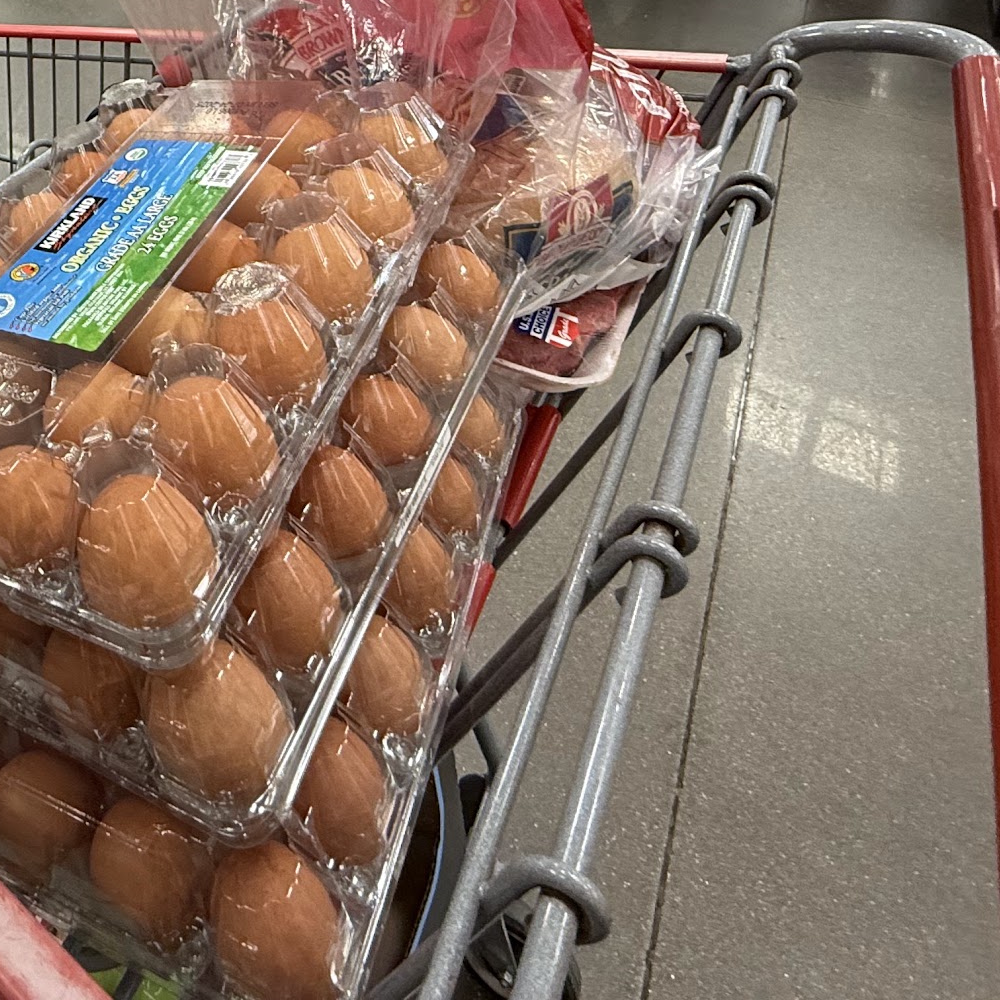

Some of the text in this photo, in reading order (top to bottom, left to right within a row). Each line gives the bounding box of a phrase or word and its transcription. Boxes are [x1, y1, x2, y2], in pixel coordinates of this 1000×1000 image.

[38, 197, 97, 249] KIRKLAND
[60, 220, 119, 273] ORGANIC
[115, 185, 151, 214] EGGS
[94, 236, 138, 272] GRADE
[126, 221, 145, 238] AA
[141, 193, 174, 223] LARGE
[136, 241, 157, 254] 24
[147, 215, 179, 241] EGGS
[533, 307, 550, 334] CHOICE
